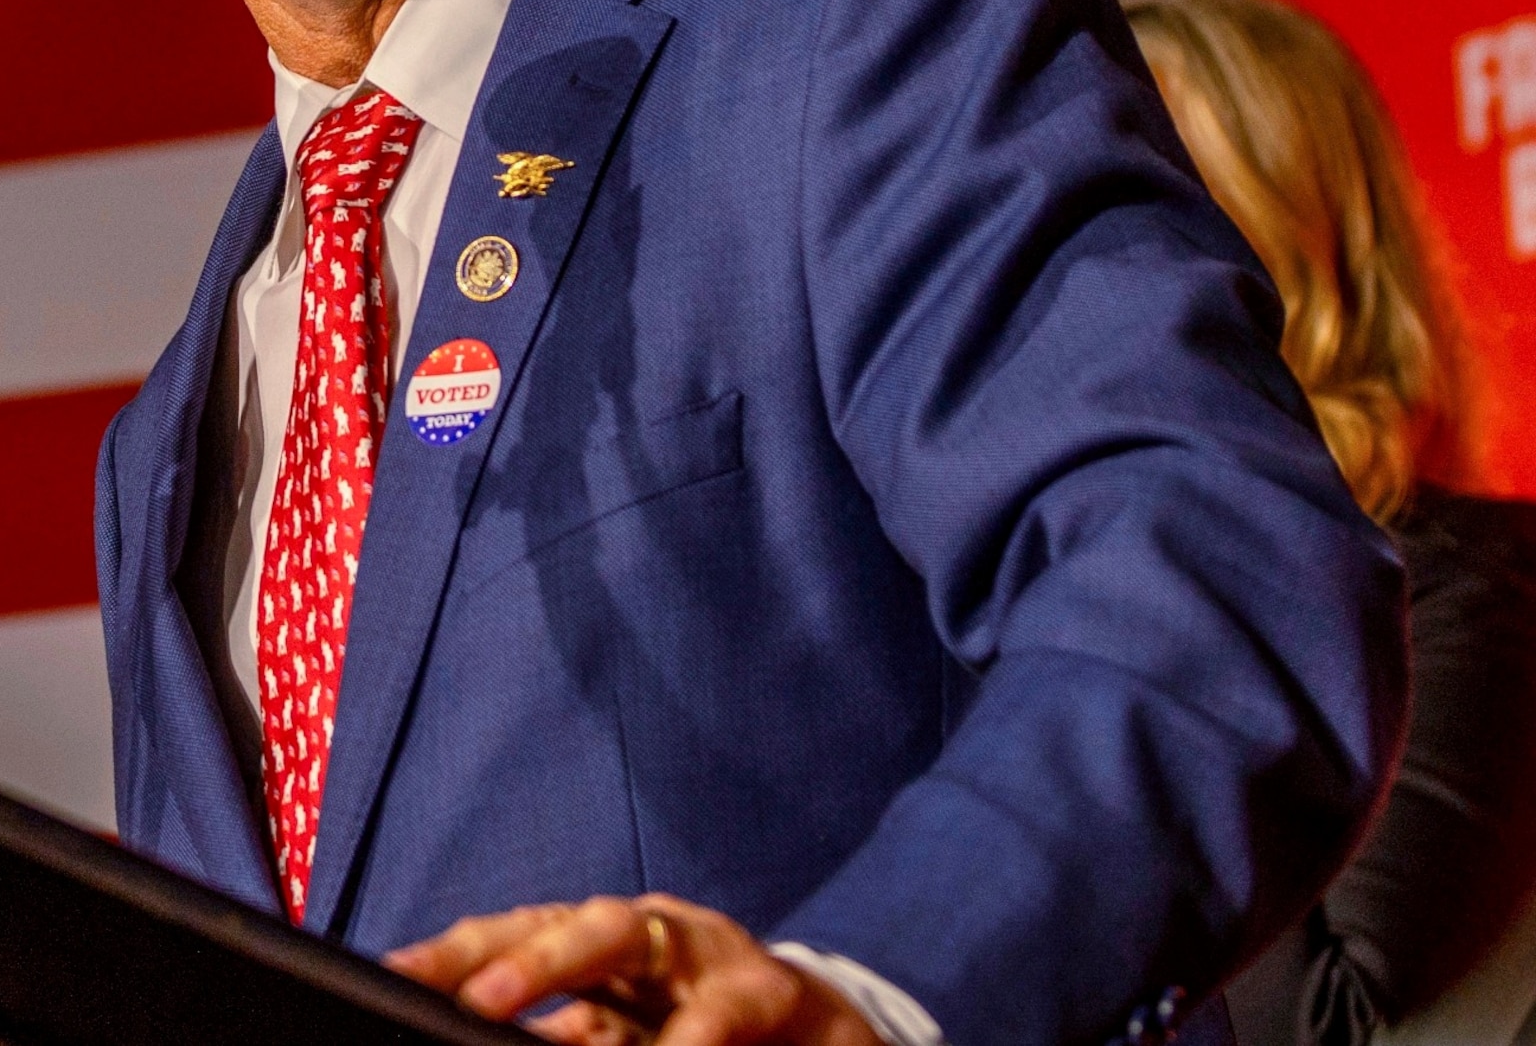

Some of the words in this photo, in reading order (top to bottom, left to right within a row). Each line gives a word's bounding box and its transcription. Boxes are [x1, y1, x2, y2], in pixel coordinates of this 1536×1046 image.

[452, 354, 465, 372] I
[416, 383, 491, 405] VOTED
[426, 413, 473, 428] TODAY
